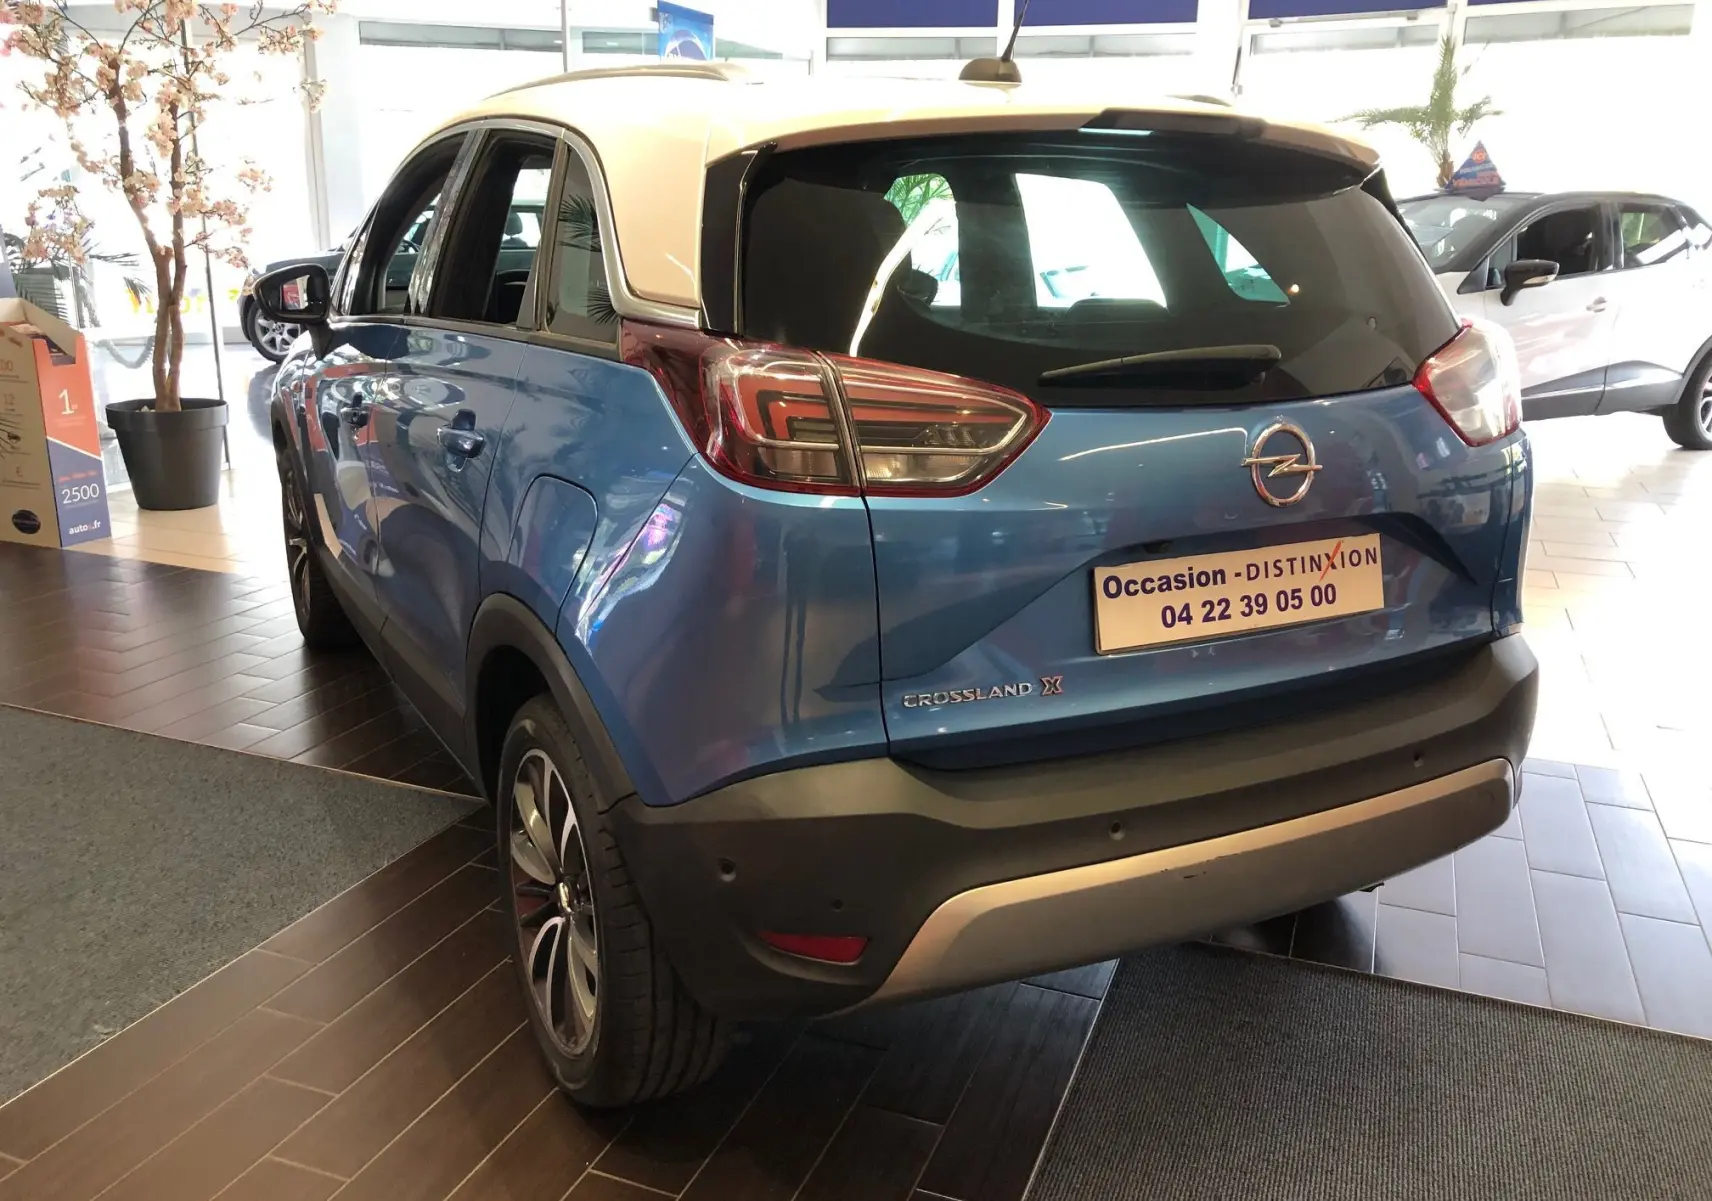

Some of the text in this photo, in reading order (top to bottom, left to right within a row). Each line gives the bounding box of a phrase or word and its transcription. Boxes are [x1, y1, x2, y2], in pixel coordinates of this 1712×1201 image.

[62, 483, 100, 504] 2500
[1103, 567, 1226, 599] Occasion
[1161, 583, 1337, 629] 04 22 39 05 00
[903, 675, 1065, 709] CROSSLAND X
